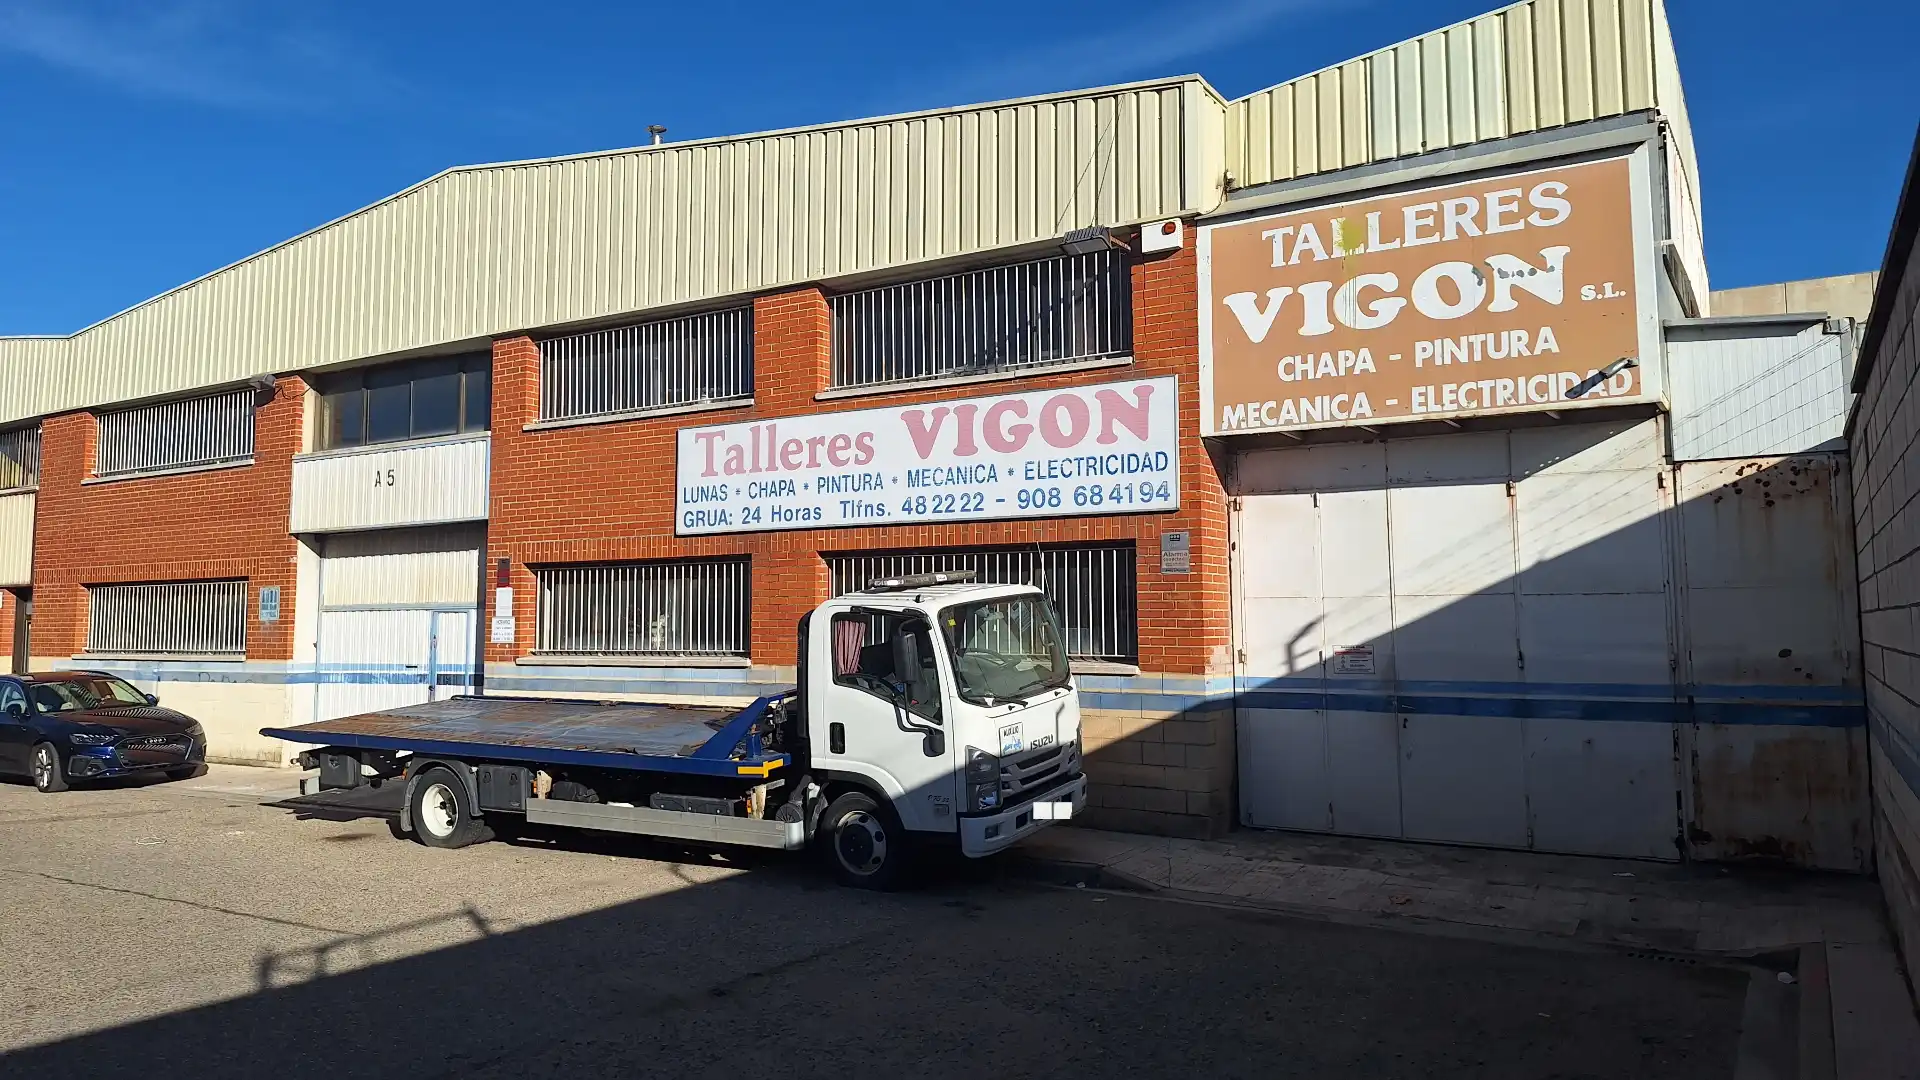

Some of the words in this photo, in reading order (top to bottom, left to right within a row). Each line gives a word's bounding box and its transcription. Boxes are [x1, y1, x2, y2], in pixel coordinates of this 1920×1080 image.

[1262, 181, 1573, 268] TALLERES
[1222, 245, 1571, 343] VIGON
[1580, 282, 1626, 301] S.L.
[1277, 347, 1376, 382] CHAPA
[1415, 326, 1560, 368] PINTURA
[1222, 391, 1373, 430] MECANICA
[1411, 368, 1633, 414] ELECTRICIDAD
[694, 423, 875, 478] Talleres
[900, 384, 1155, 460] VIGON
[683, 484, 728, 504] LUNAS
[748, 479, 796, 499] CHAPA
[817, 472, 884, 495] PINTURA
[907, 463, 998, 488] MECANICA
[1024, 451, 1169, 481] ELECTRICIDAD
[683, 508, 733, 528] GRUA:
[741, 506, 762, 525] 24
[771, 505, 822, 523] Horas
[840, 500, 891, 519] Tlfns.
[1017, 487, 1062, 509] 908
[1030, 733, 1054, 751] ISUZU
